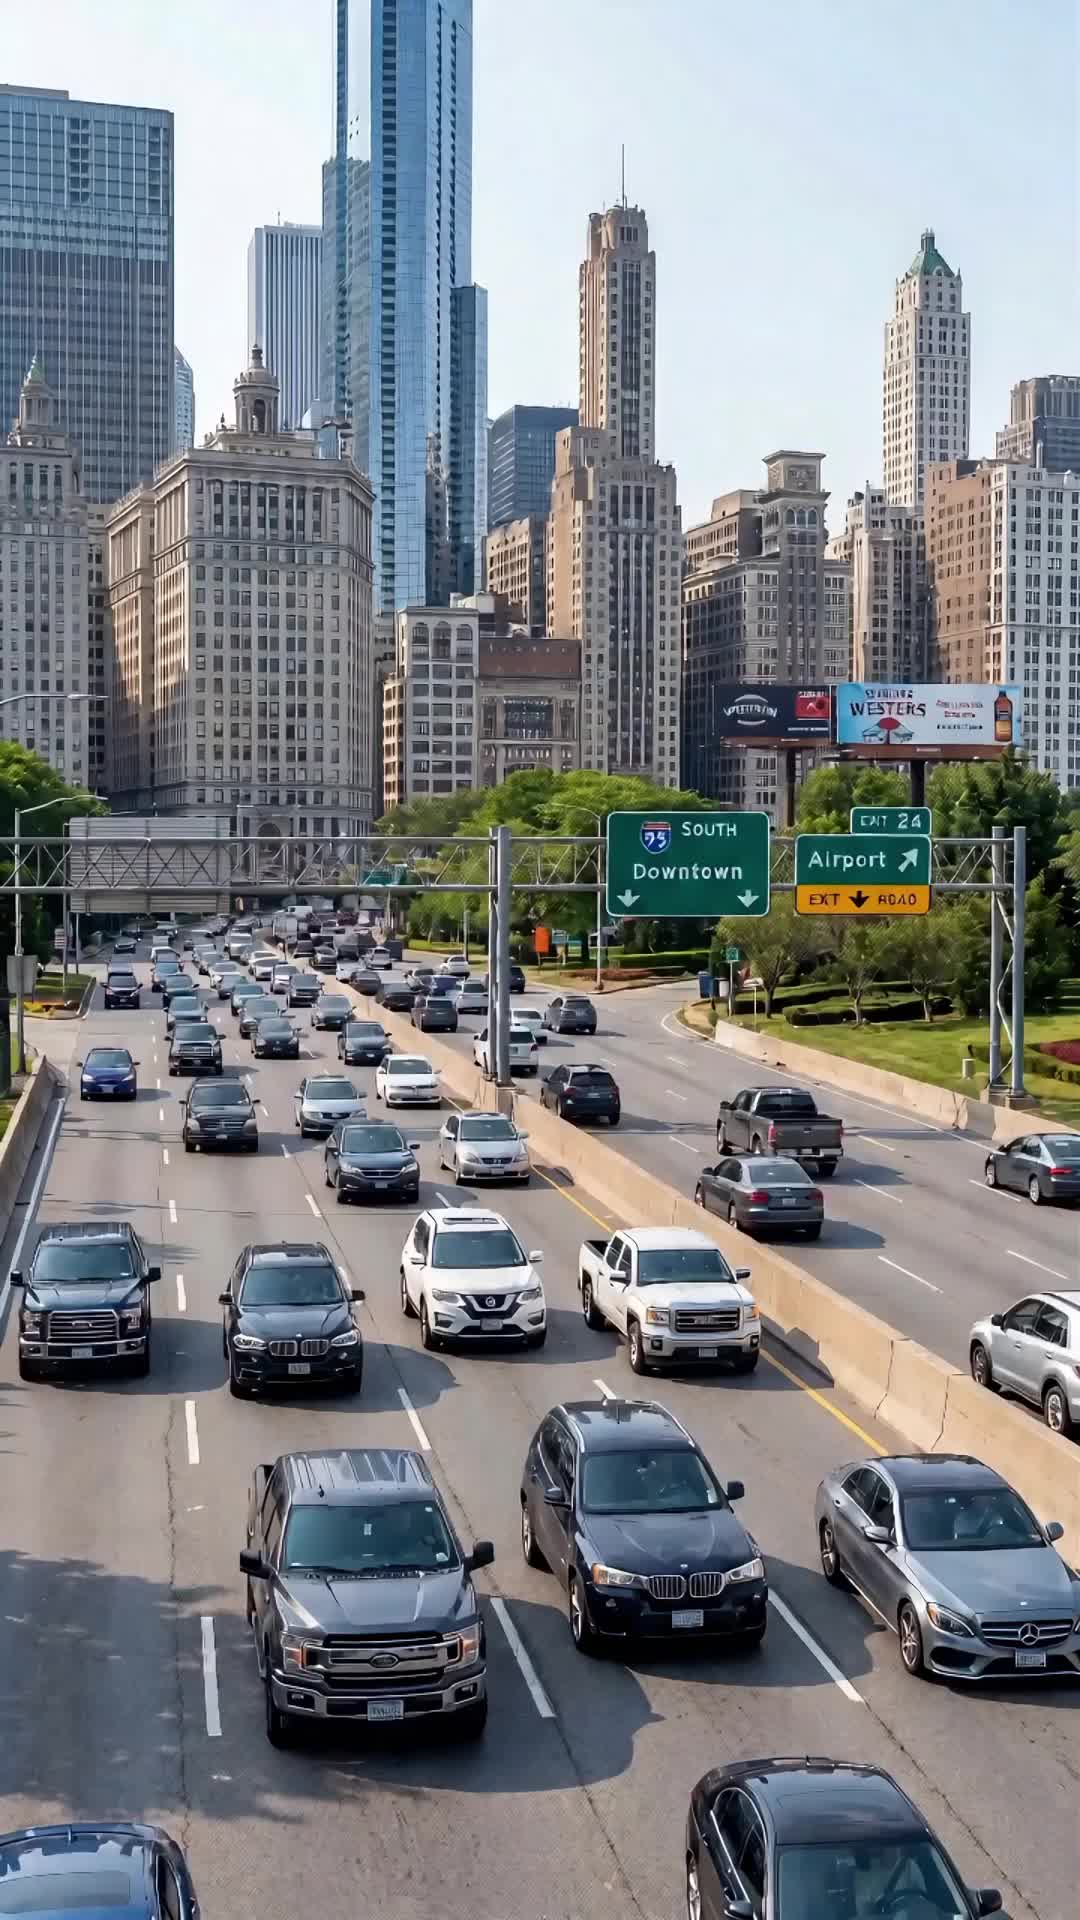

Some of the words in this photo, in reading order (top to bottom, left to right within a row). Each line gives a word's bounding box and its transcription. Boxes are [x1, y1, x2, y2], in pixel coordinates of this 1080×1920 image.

[681, 821, 737, 837] SOUTH
[897, 813, 922, 829] 24
[808, 850, 886, 872] Airport
[633, 863, 743, 880] Downtown
